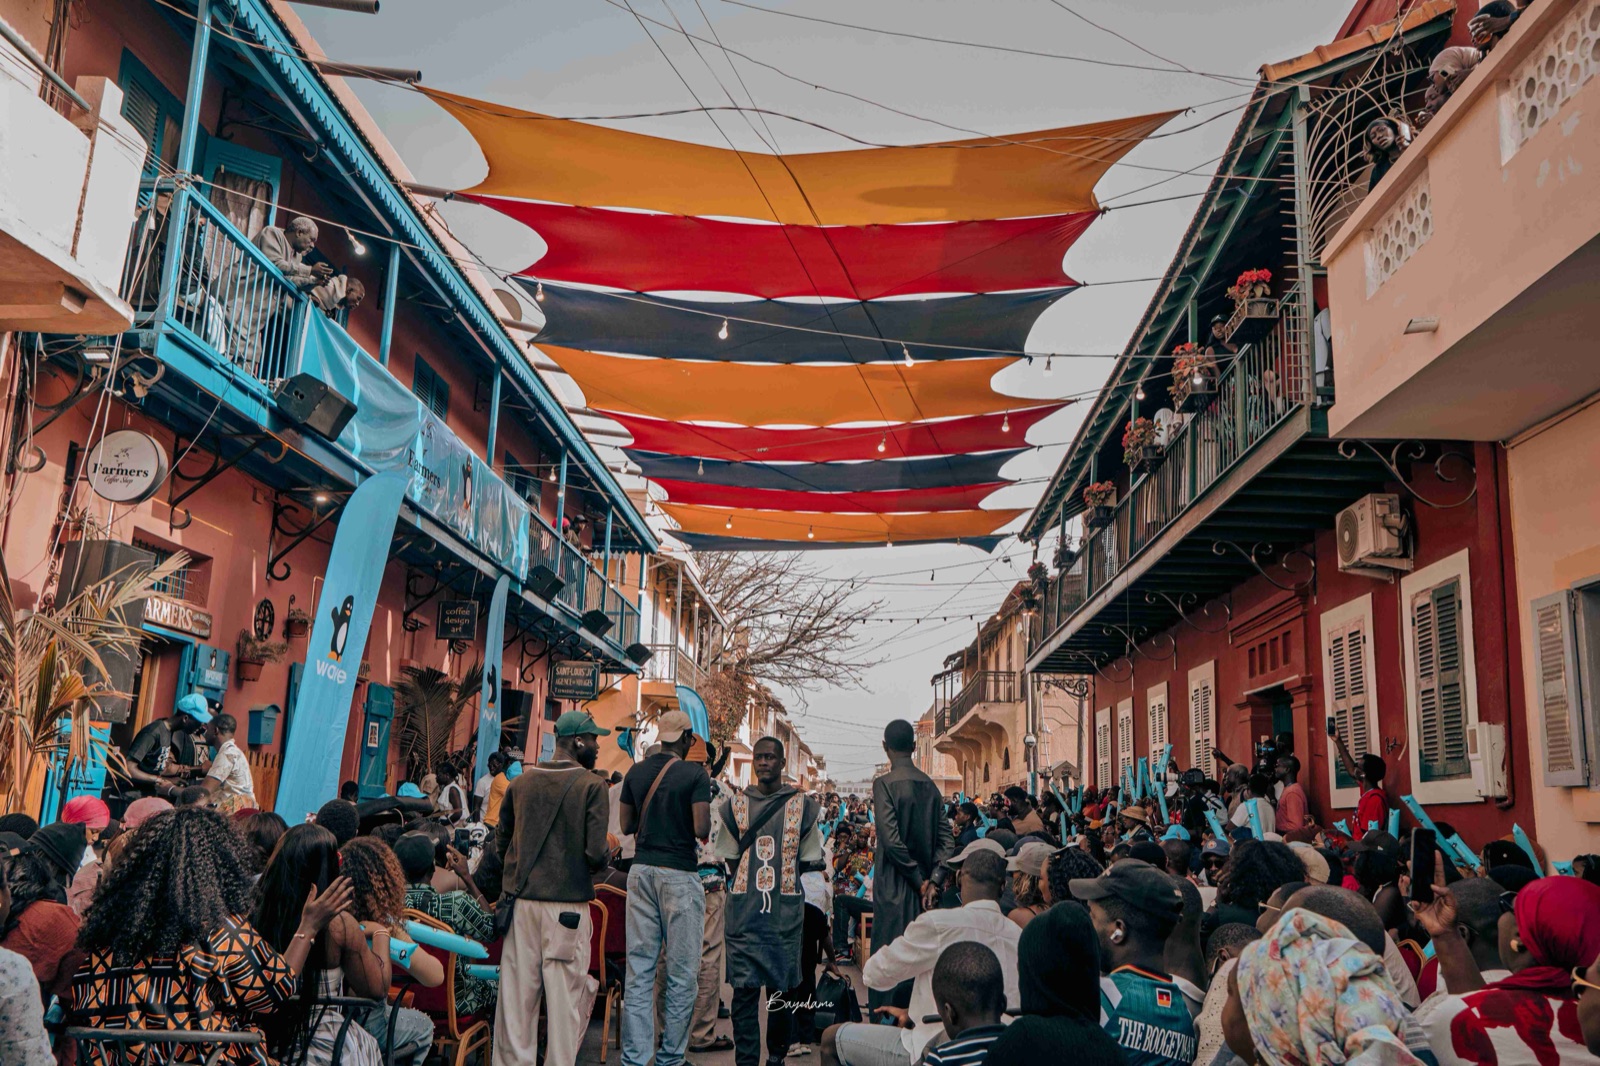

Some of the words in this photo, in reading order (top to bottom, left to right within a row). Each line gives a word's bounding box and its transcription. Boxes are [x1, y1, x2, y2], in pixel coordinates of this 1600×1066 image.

[93, 463, 149, 477] Farmers
[408, 449, 440, 488] Farmers
[103, 476, 119, 485] Coffee
[120, 476, 133, 487] Shop
[144, 597, 192, 630] ARMERS
[445, 606, 470, 616] coffee
[444, 616, 470, 626] design
[1118, 1016, 1145, 1050] THE
